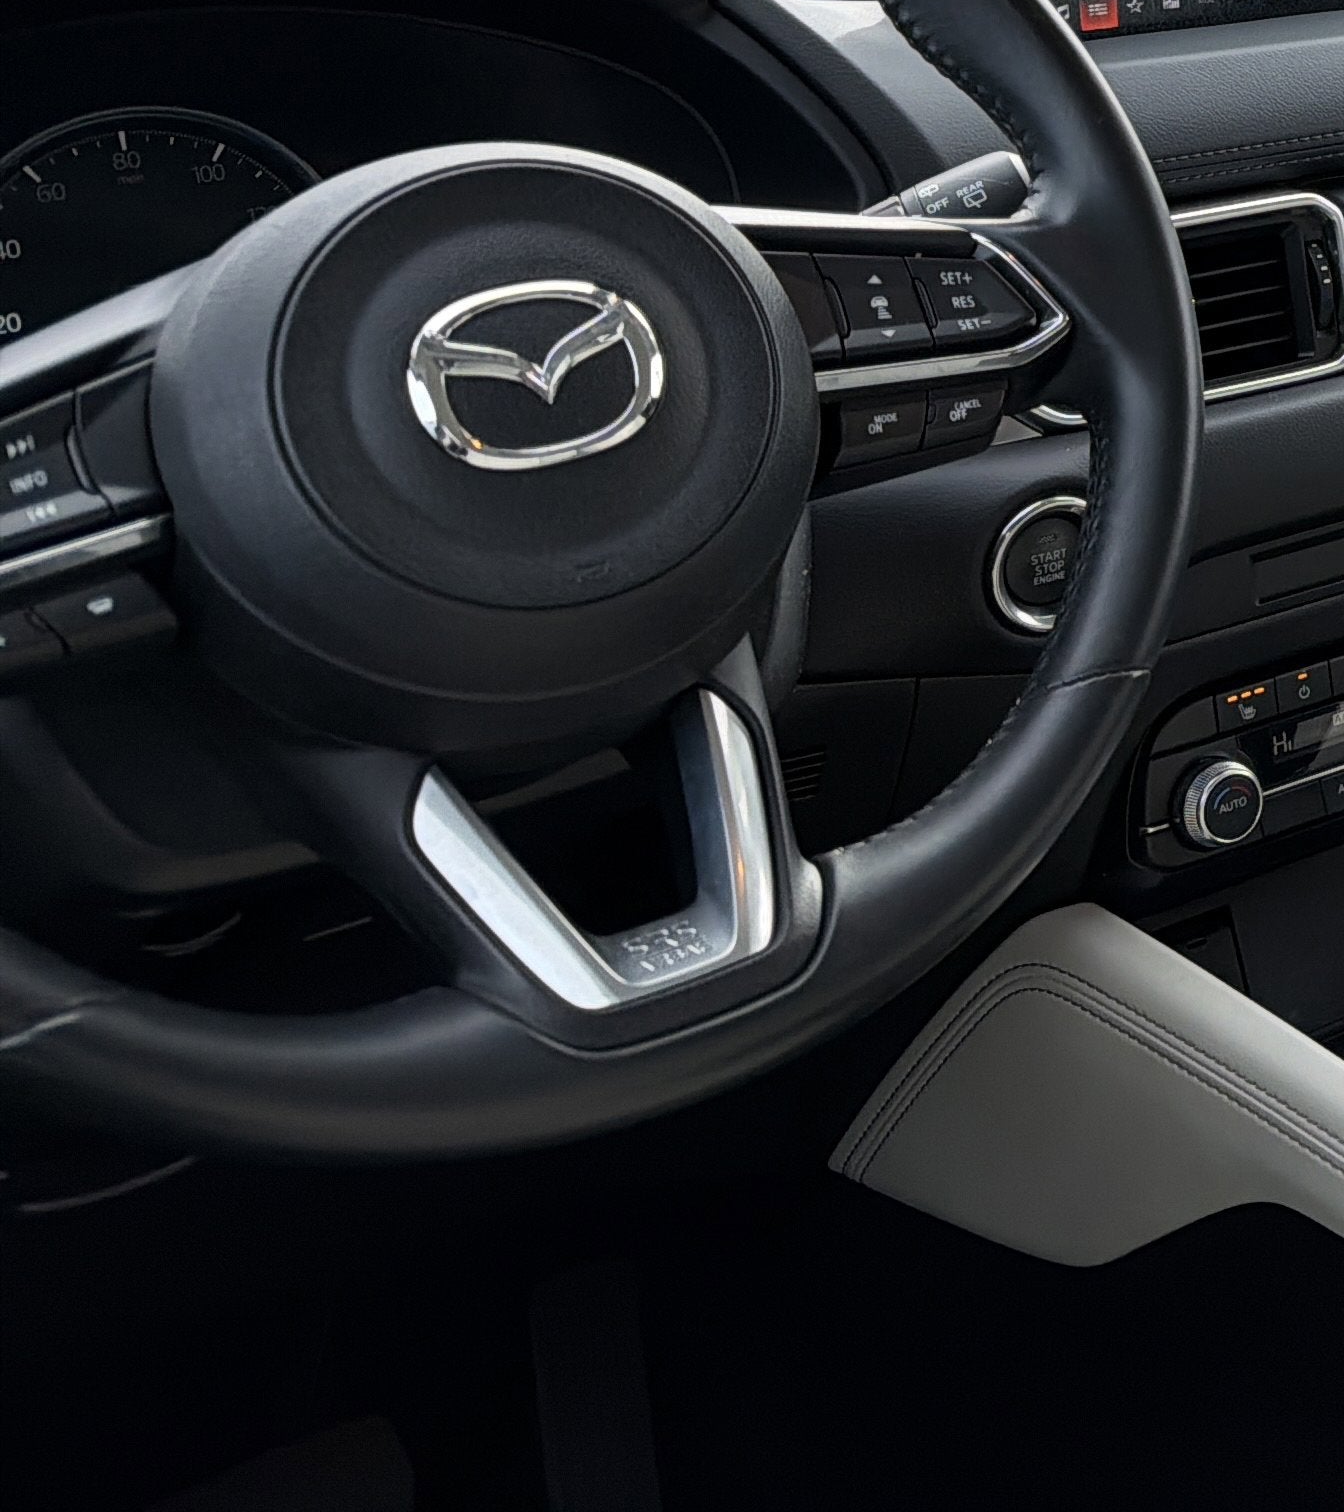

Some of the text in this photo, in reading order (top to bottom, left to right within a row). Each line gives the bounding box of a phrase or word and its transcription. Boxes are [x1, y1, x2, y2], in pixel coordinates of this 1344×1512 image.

[112, 151, 142, 172] 80
[191, 163, 226, 185] 100
[36, 183, 66, 202] 60
[956, 180, 984, 198] REAR
[926, 196, 950, 216] OFF
[951, 296, 976, 309] RES
[954, 399, 982, 410] CANCEL
[874, 412, 898, 423] MODE
[949, 409, 968, 422] OFF
[868, 423, 883, 435] ON
[1030, 548, 1067, 566] START
[1035, 560, 1065, 576] STOP
[1033, 571, 1065, 586] ENGINE
[1218, 796, 1248, 815] AUTO
